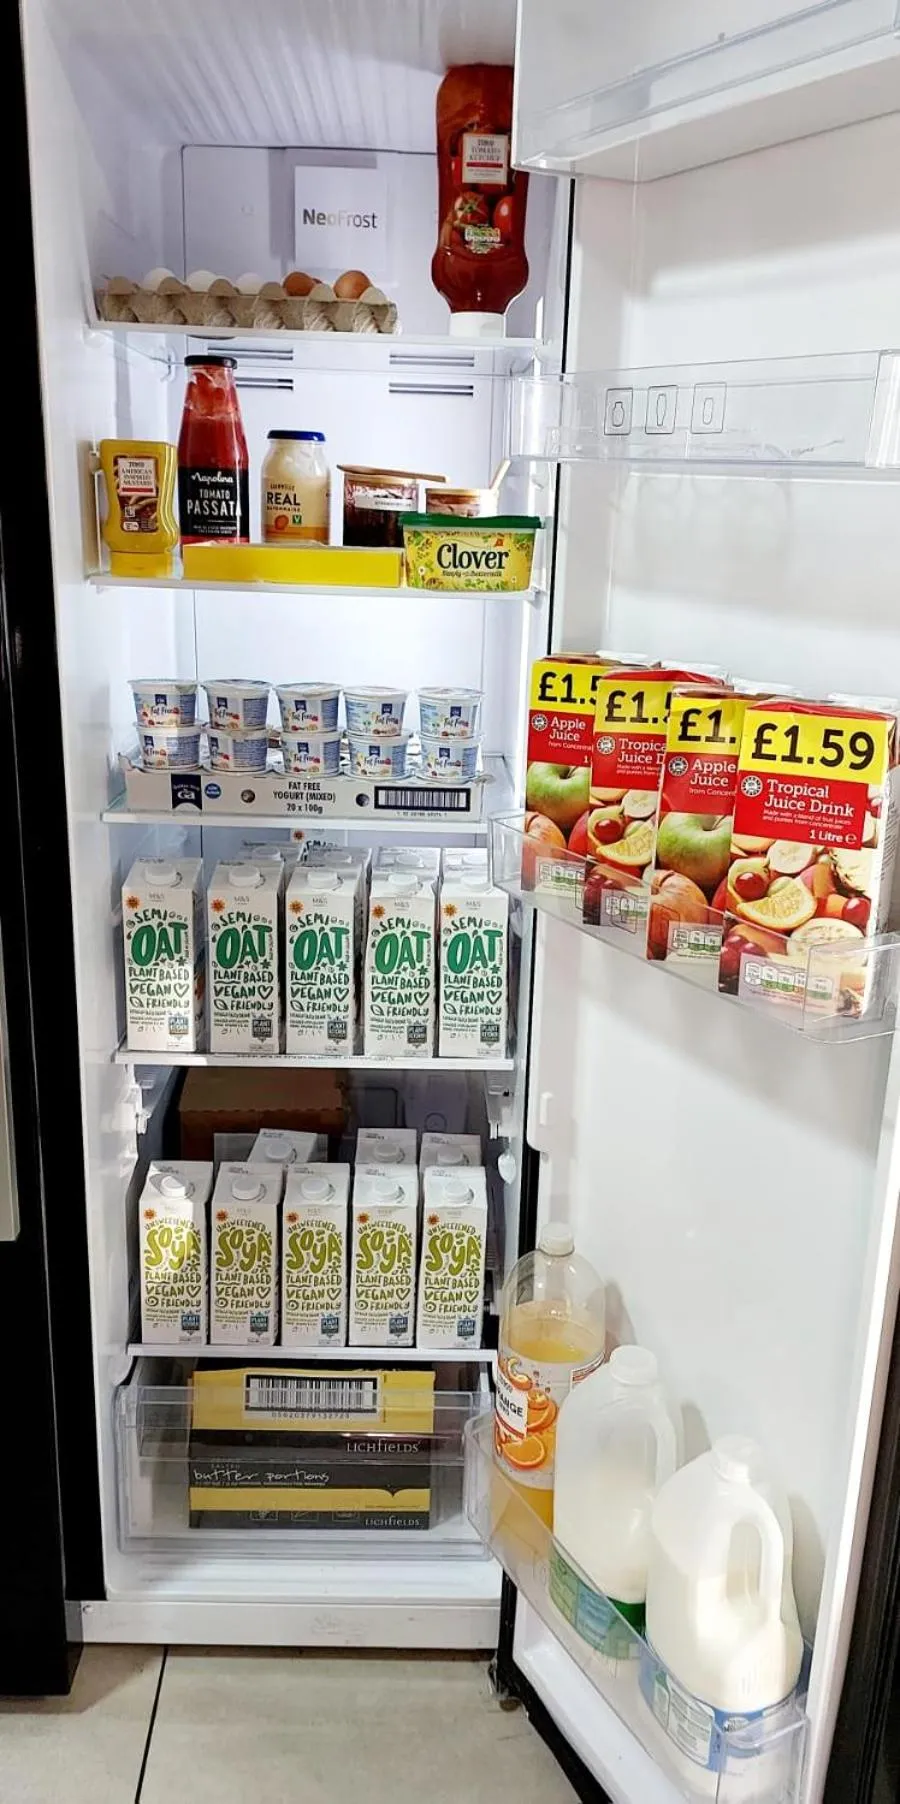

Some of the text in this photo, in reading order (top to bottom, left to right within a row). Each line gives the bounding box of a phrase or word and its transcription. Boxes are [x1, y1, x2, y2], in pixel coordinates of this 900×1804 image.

[303, 209, 378, 229] NeoFrost
[200, 489, 230, 499] TOMATO
[267, 492, 300, 505] REAL
[187, 499, 241, 516] PASSATA
[437, 543, 509, 569] Clover
[550, 716, 586, 729] Apple
[549, 729, 580, 741] Juice
[752, 722, 875, 770] £1.59
[617, 751, 652, 763] Juice
[691, 759, 736, 775] Apple
[690, 773, 728, 786] Juice
[288, 782, 321, 791] FAT FREE
[767, 779, 829, 798] Tropical
[272, 791, 336, 803] YOGURT (MIXED)
[286, 803, 296, 812] 20
[304, 803, 323, 814] 100g
[764, 795, 854, 817] Juice Drink
[810, 830, 843, 842] 1 Litre
[134, 908, 168, 924] SEMI
[220, 912, 251, 926] SEMI
[297, 913, 330, 927] SEMI
[379, 917, 411, 932] SEMI
[451, 917, 482, 931] SEMI
[131, 922, 188, 966] OAT
[216, 925, 272, 969] OAT
[293, 926, 349, 971] OAT
[375, 930, 431, 975] OAT
[447, 929, 503, 974] OAT
[128, 967, 189, 981] PLANT BASED
[214, 970, 273, 983] PLANT BASED
[291, 971, 349, 985] PLANT BASED
[371, 976, 430, 989] PLANT BASED
[443, 976, 502, 988] PLANT BASED
[129, 983, 171, 997] VEGAN
[214, 986, 256, 998] VEGAN
[291, 987, 332, 1000] VEGAN
[443, 990, 485, 1003] VEGAN
[146, 997, 189, 1009] FRIENDLY
[371, 991, 412, 1004] VEGAN
[231, 999, 273, 1010] FRIENDLY
[306, 1001, 349, 1013] FRIENDLY
[459, 1005, 502, 1016] FRIENDLY
[386, 1006, 429, 1017] FRIENDLY
[145, 1217, 195, 1231] UNSWEETENED
[216, 1219, 266, 1233] UNSWEETENED
[287, 1220, 336, 1235] UNSWEETENED
[357, 1220, 407, 1235] UNSWEETENED
[427, 1222, 476, 1236] UNSWEETENED
[144, 1226, 202, 1271] SOYA
[217, 1228, 272, 1272] SOYA
[286, 1229, 342, 1274] SOYA
[356, 1230, 412, 1274] SOYA
[426, 1232, 481, 1276] SOYA
[145, 1271, 201, 1284] PLANT BASED
[215, 1272, 271, 1285] PLANT BASED
[286, 1274, 342, 1287] PLANT BASED
[356, 1275, 411, 1287] PLANT BASED
[425, 1278, 480, 1289] PLANT BASED
[146, 1286, 185, 1298] VEGAN
[215, 1286, 255, 1299] VEGAN
[286, 1288, 325, 1301] VEGAN
[356, 1289, 394, 1301] VEGAN
[424, 1291, 463, 1303] VEGAN
[161, 1299, 201, 1308] FRIENDLY
[230, 1300, 271, 1309] FRIENDLY
[301, 1302, 341, 1311] FRIENDLY
[370, 1302, 410, 1311] FRIENDLY
[438, 1305, 479, 1313] FRIENDLY
[193, 1469, 330, 1482] butter portions
